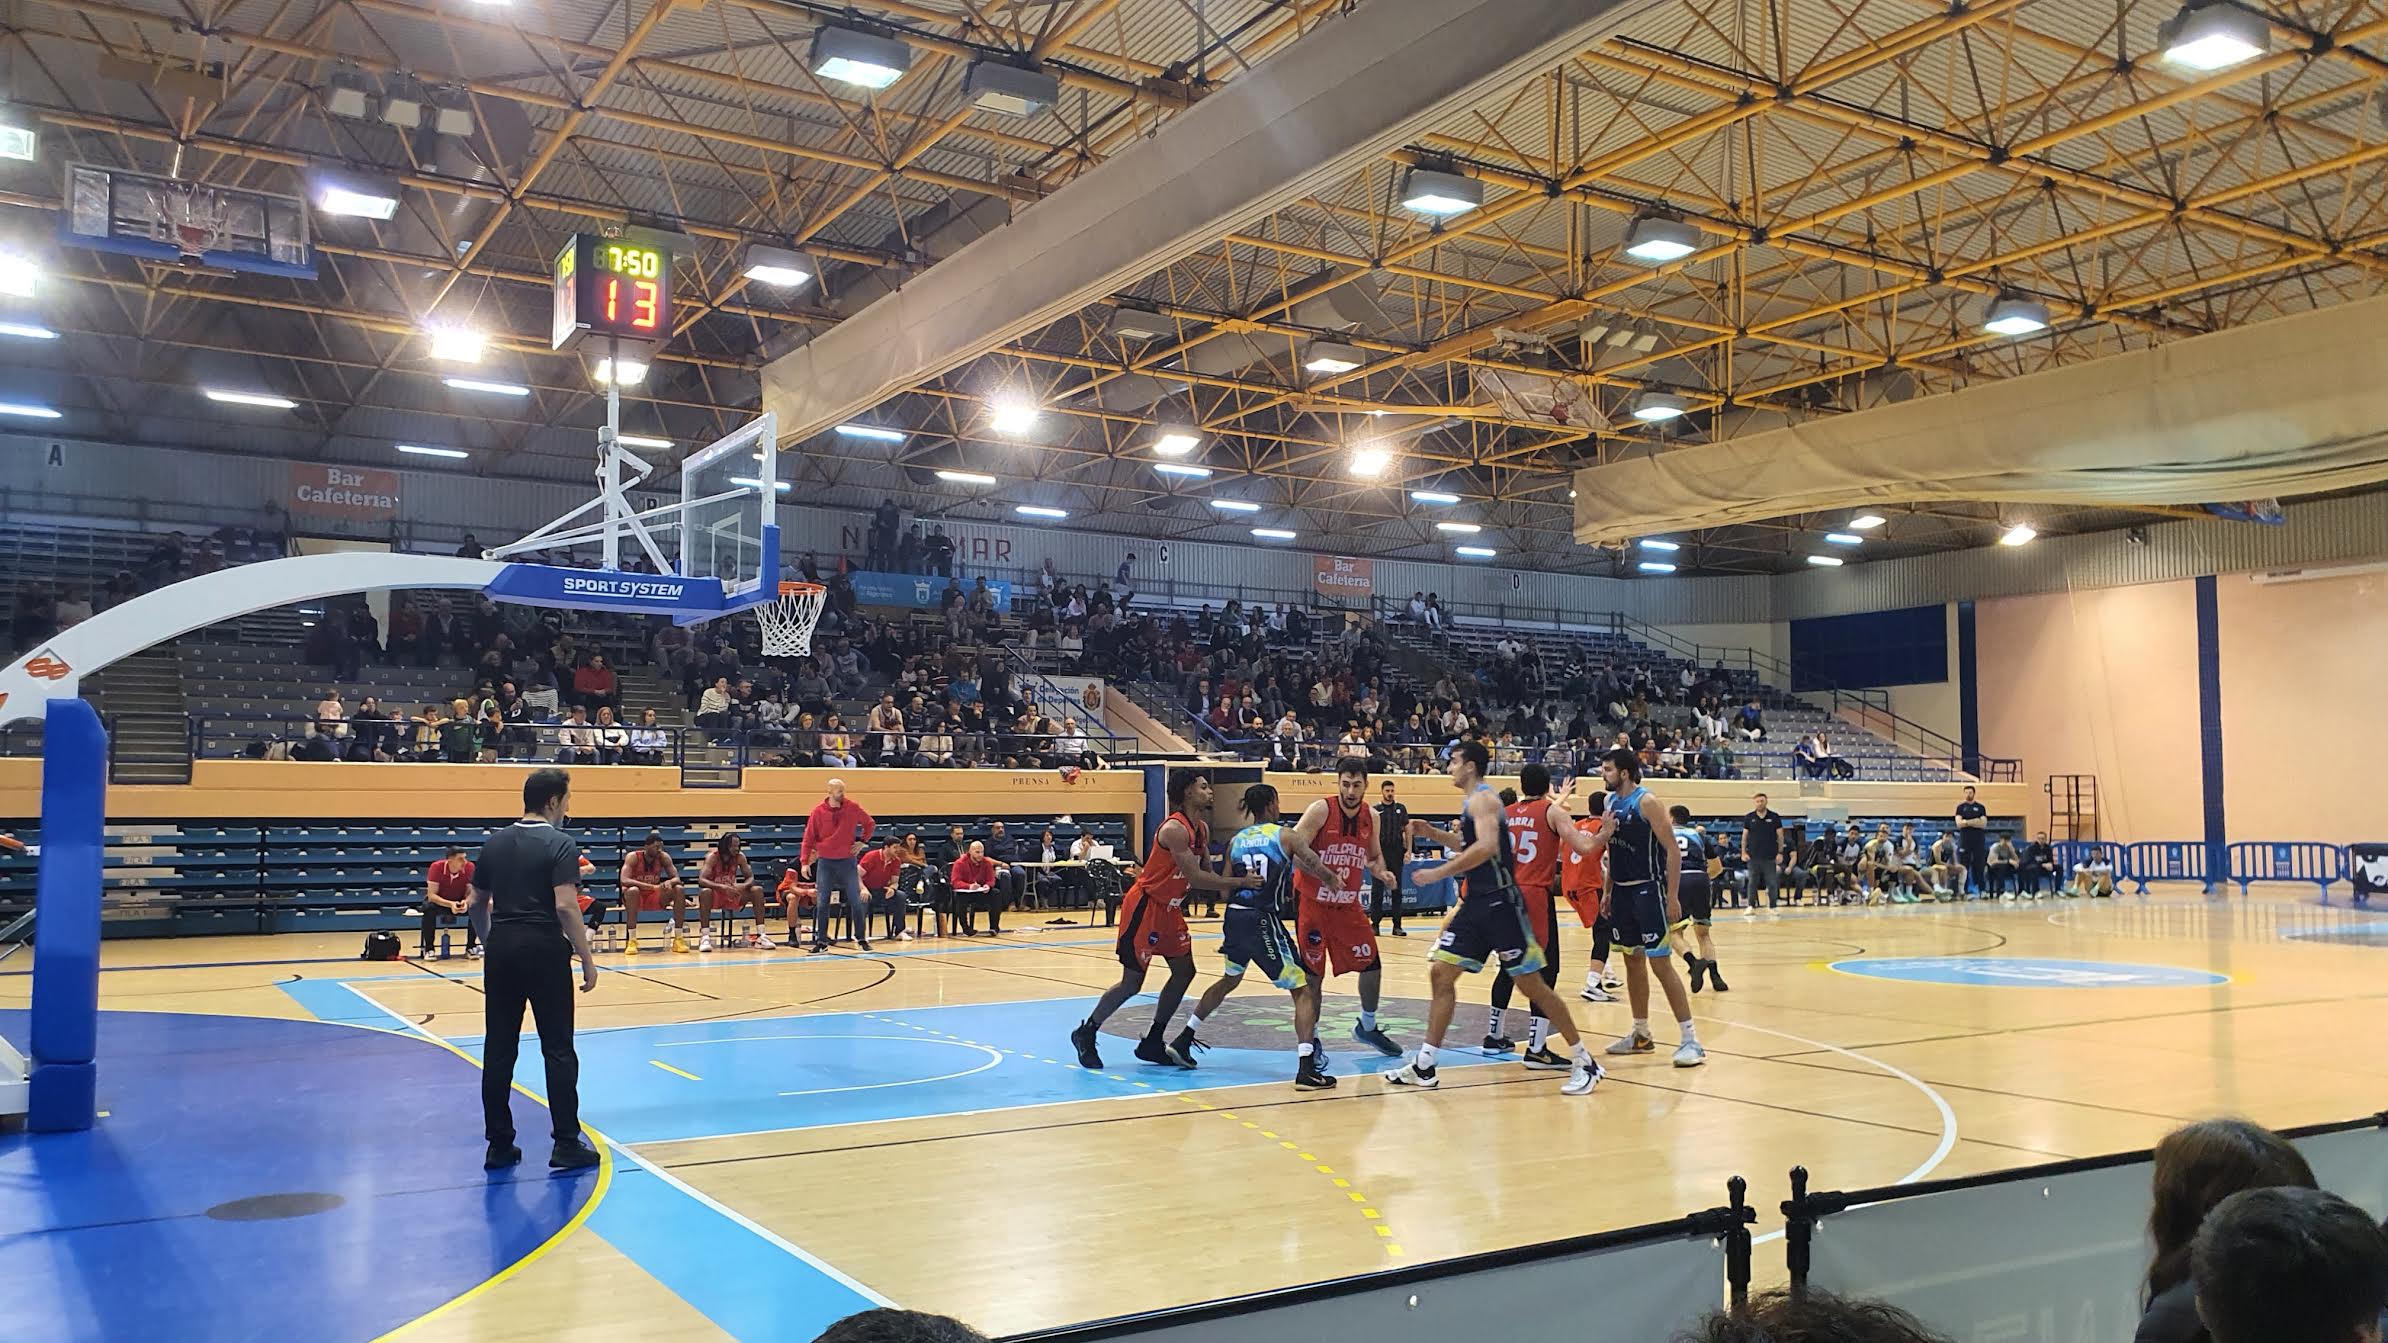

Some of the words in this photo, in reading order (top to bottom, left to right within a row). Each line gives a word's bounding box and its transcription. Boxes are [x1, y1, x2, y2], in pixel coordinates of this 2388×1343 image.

[609, 247, 658, 278] 7:50
[607, 279, 658, 328] 13
[48, 444, 63, 466] A
[327, 468, 364, 486] Bar
[1159, 546, 1169, 562] C
[1334, 559, 1355, 573] Bar
[563, 577, 619, 593] SPORT
[619, 581, 684, 598] SYSTEM
[1512, 574, 1521, 590] D
[1012, 777, 1050, 786] PRENSA
[1351, 943, 1371, 958] 20
